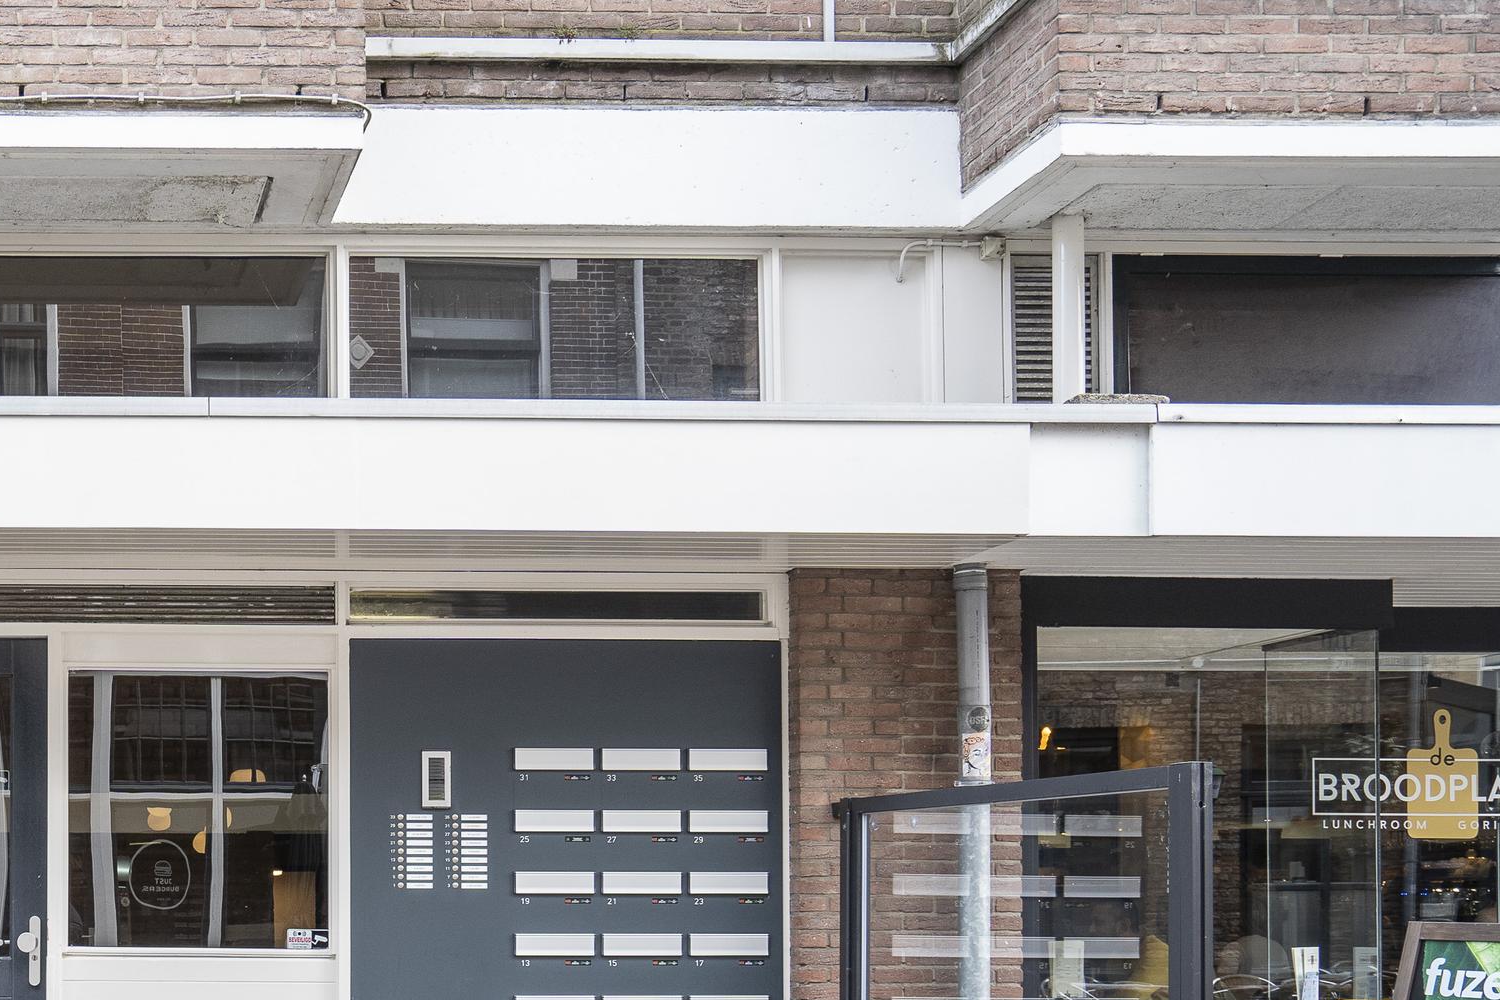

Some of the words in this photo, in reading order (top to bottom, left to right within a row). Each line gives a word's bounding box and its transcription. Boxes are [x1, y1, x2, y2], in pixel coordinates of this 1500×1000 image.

[1430, 747, 1455, 766] de
[519, 773, 529, 782] 31
[606, 773, 617, 782] 33
[693, 773, 704, 782] 35
[1322, 819, 1428, 830] LUNCHROOM
[519, 835, 530, 844] 25
[606, 835, 617, 844] 27
[693, 835, 704, 844] 29
[520, 897, 530, 906] 19
[607, 897, 617, 906] 21
[694, 897, 704, 906] 23
[521, 959, 531, 967] 13
[608, 959, 618, 967] 15
[695, 959, 705, 967] 17
[1424, 957, 1500, 1000] fuze
